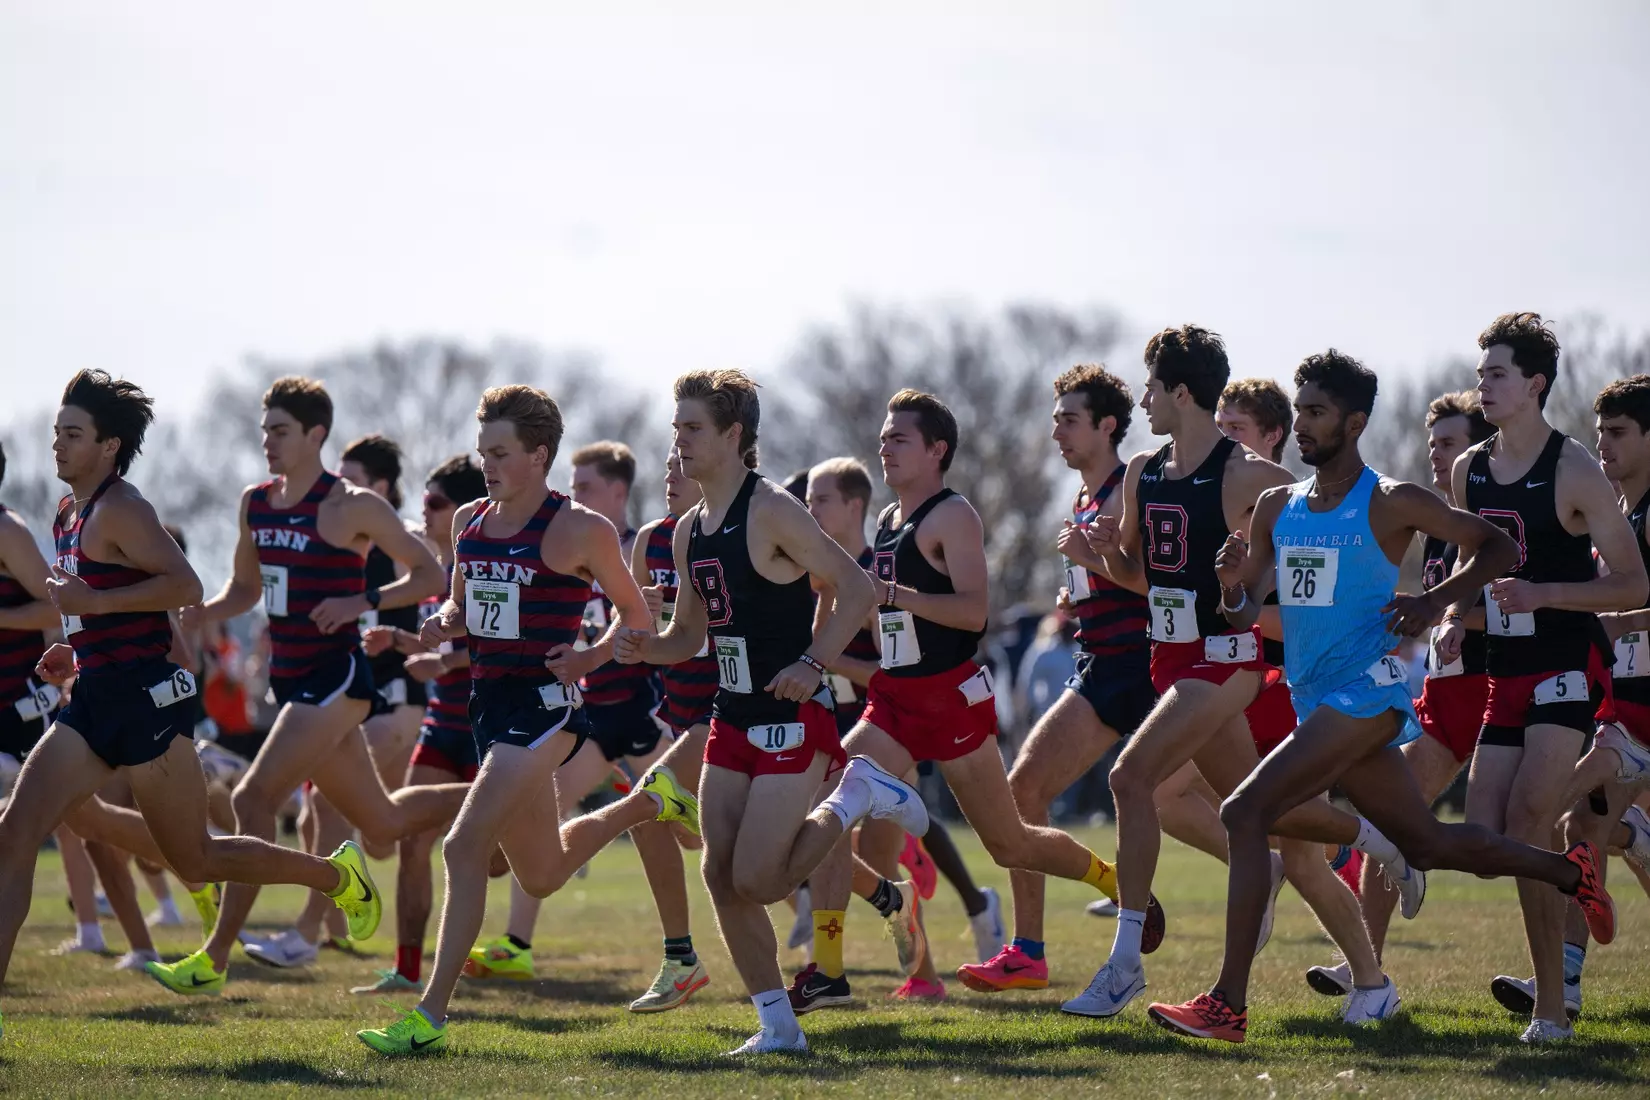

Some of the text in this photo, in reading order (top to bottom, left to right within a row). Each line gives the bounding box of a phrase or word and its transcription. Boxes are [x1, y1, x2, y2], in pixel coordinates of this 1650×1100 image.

[1146, 503, 1188, 573] B
[1275, 534, 1363, 548] COLUMBIA
[458, 560, 538, 587] PENN
[1292, 568, 1317, 599] 26
[691, 558, 733, 628] B
[479, 601, 501, 631] 72
[1163, 608, 1175, 636] 3
[888, 633, 897, 660] 7
[1228, 636, 1239, 659] 3
[1628, 644, 1635, 671] 2
[721, 656, 738, 686] 10
[976, 671, 992, 693] 7
[1381, 657, 1403, 680] 26
[169, 671, 192, 699] 78
[1555, 674, 1567, 697] 5
[32, 689, 50, 713] 79
[764, 725, 787, 749] 10
